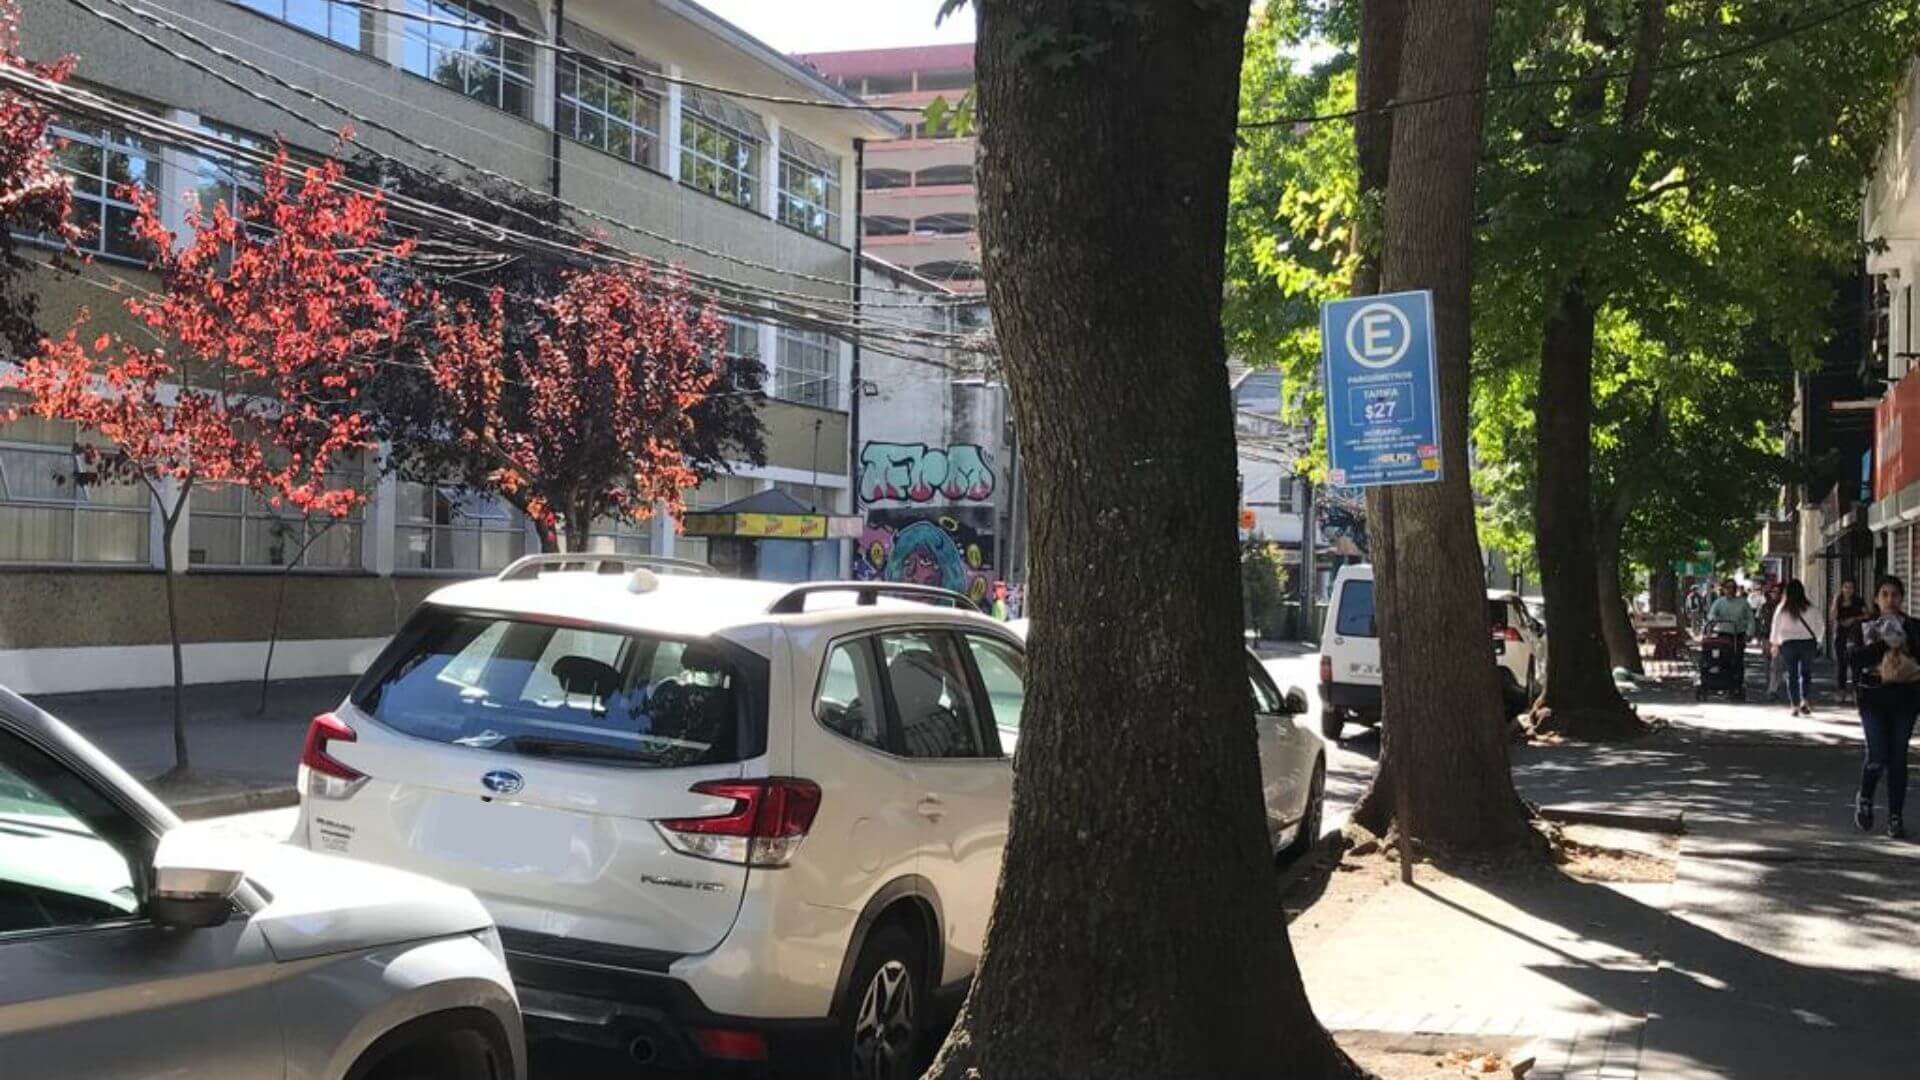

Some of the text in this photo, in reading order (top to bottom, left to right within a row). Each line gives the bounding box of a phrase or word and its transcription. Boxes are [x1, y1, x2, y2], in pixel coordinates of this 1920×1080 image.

[1363, 314, 1393, 357] E
[1363, 388, 1399, 400] TARIFA
[1364, 401, 1396, 420] $27
